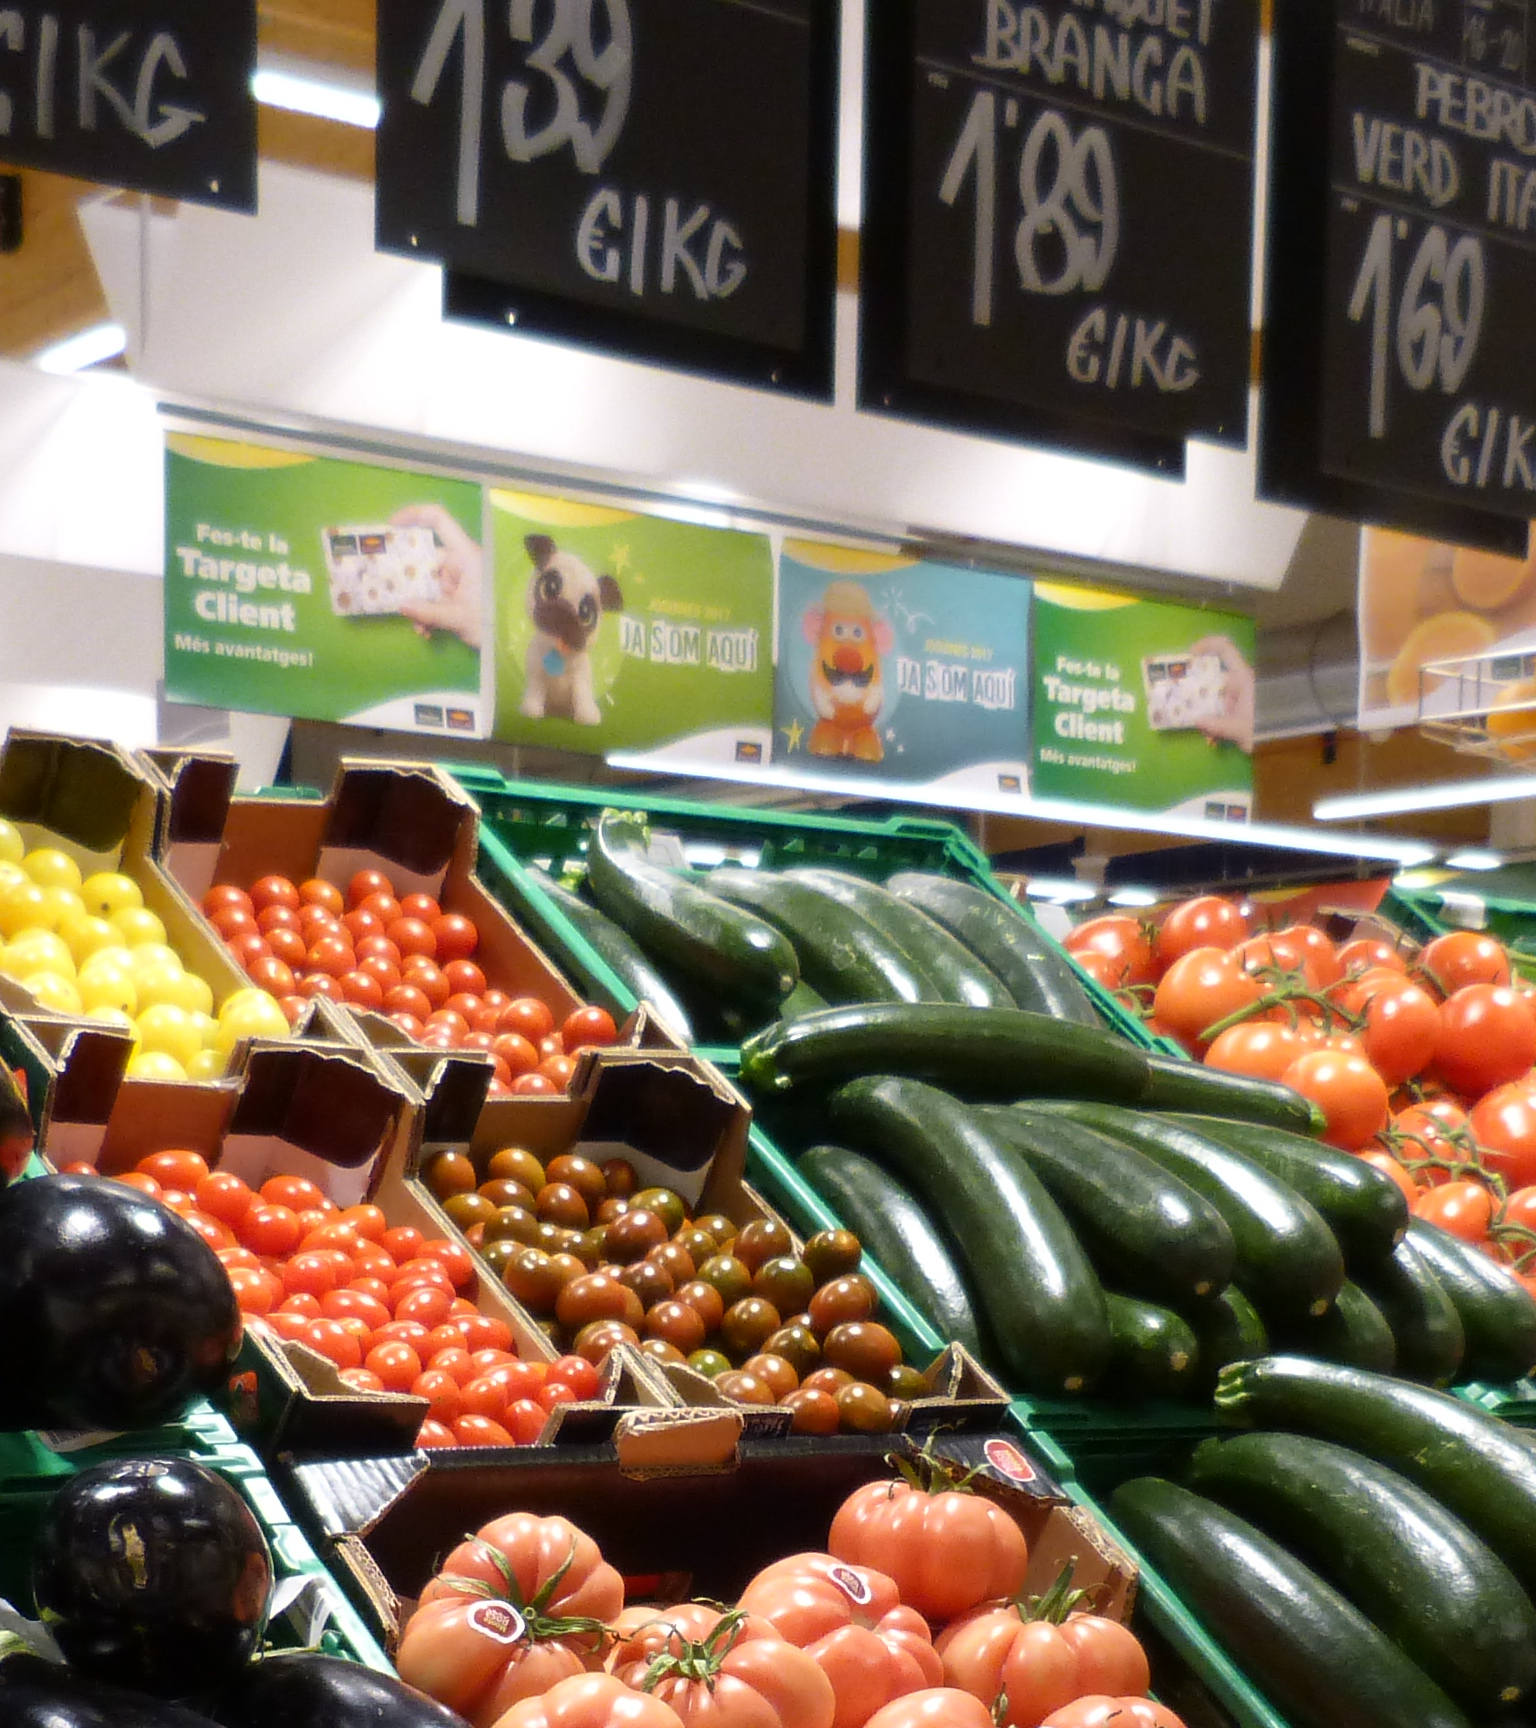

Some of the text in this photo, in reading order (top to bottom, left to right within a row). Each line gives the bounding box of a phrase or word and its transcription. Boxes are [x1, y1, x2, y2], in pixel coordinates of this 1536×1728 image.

[1352, 111, 1461, 209] VERD
[195, 521, 289, 556] Fes-te la
[176, 546, 312, 594] Targeta
[194, 590, 296, 633] Client
[174, 633, 313, 668] Més avantatges!
[622, 621, 644, 654] JA
[709, 630, 756, 671] AQUÍ
[901, 659, 919, 692] JA
[1043, 675, 1136, 713] Targeta
[1054, 711, 1125, 745] Client
